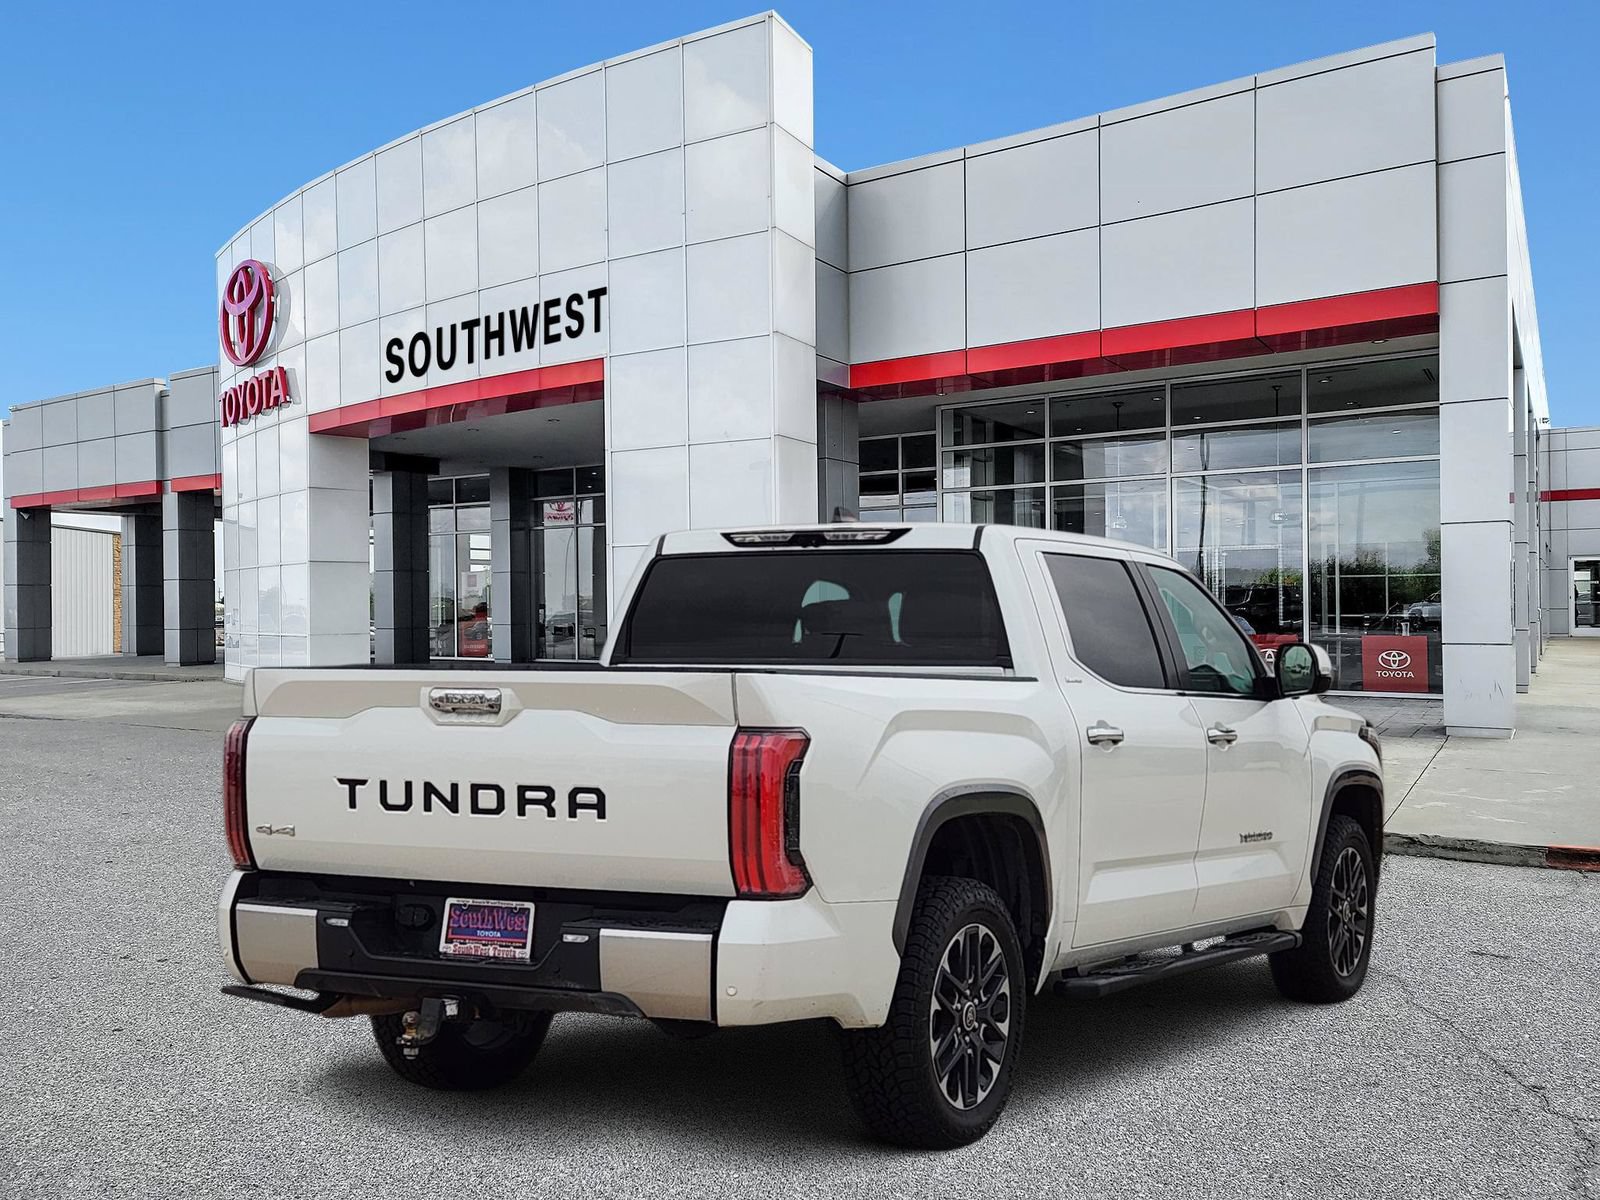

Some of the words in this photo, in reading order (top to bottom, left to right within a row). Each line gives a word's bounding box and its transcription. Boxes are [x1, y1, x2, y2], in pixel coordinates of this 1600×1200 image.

[385, 286, 608, 384] SOUTHWEST
[219, 366, 291, 428] TOYOTA
[1376, 670, 1414, 678] TOYOTA
[335, 778, 607, 821] TUNDRA
[476, 930, 501, 938] TOYOTA
